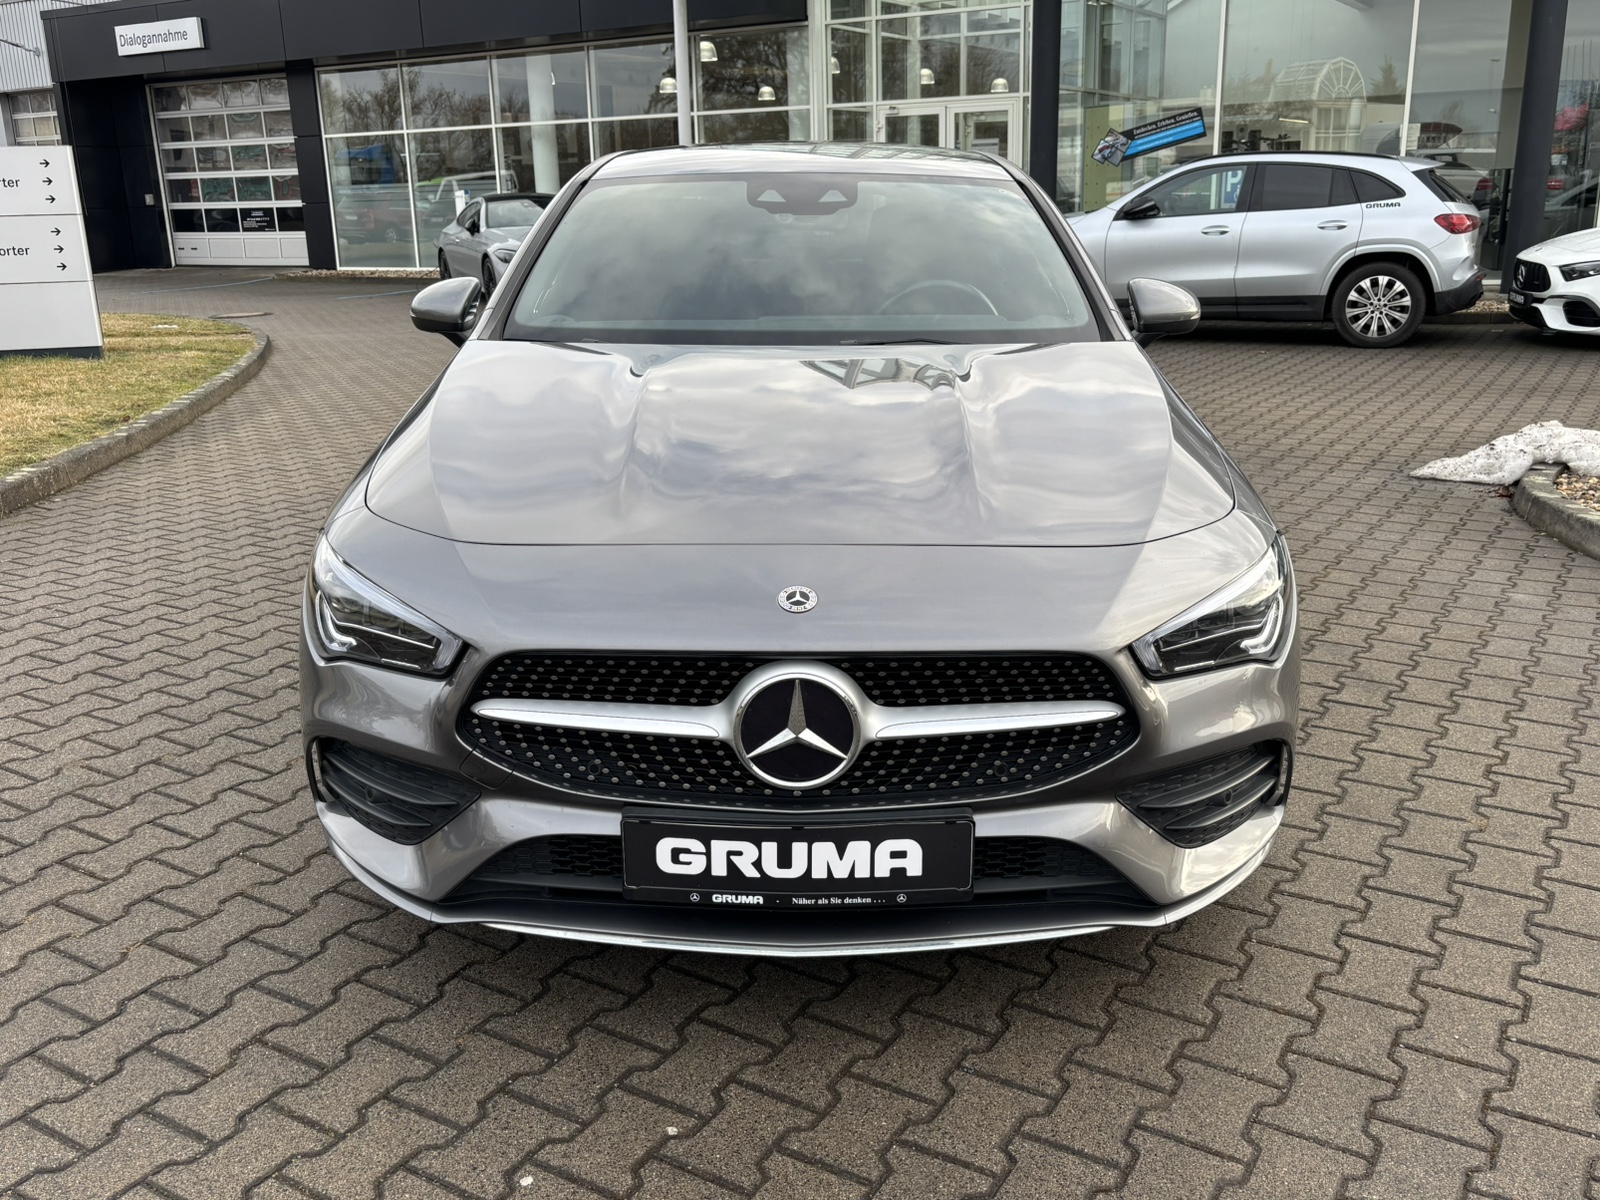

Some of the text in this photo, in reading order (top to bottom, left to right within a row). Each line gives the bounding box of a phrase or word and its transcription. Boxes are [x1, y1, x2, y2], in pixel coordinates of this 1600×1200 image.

[119, 29, 188, 48] Dialogannahme
[0, 177, 20, 188] ter
[655, 836, 924, 880] GRUMA
[711, 894, 764, 904] GRUMA
[791, 896, 815, 904] Näher
[817, 896, 829, 904] als
[830, 896, 842, 904] Sie
[843, 896, 872, 904] denken
